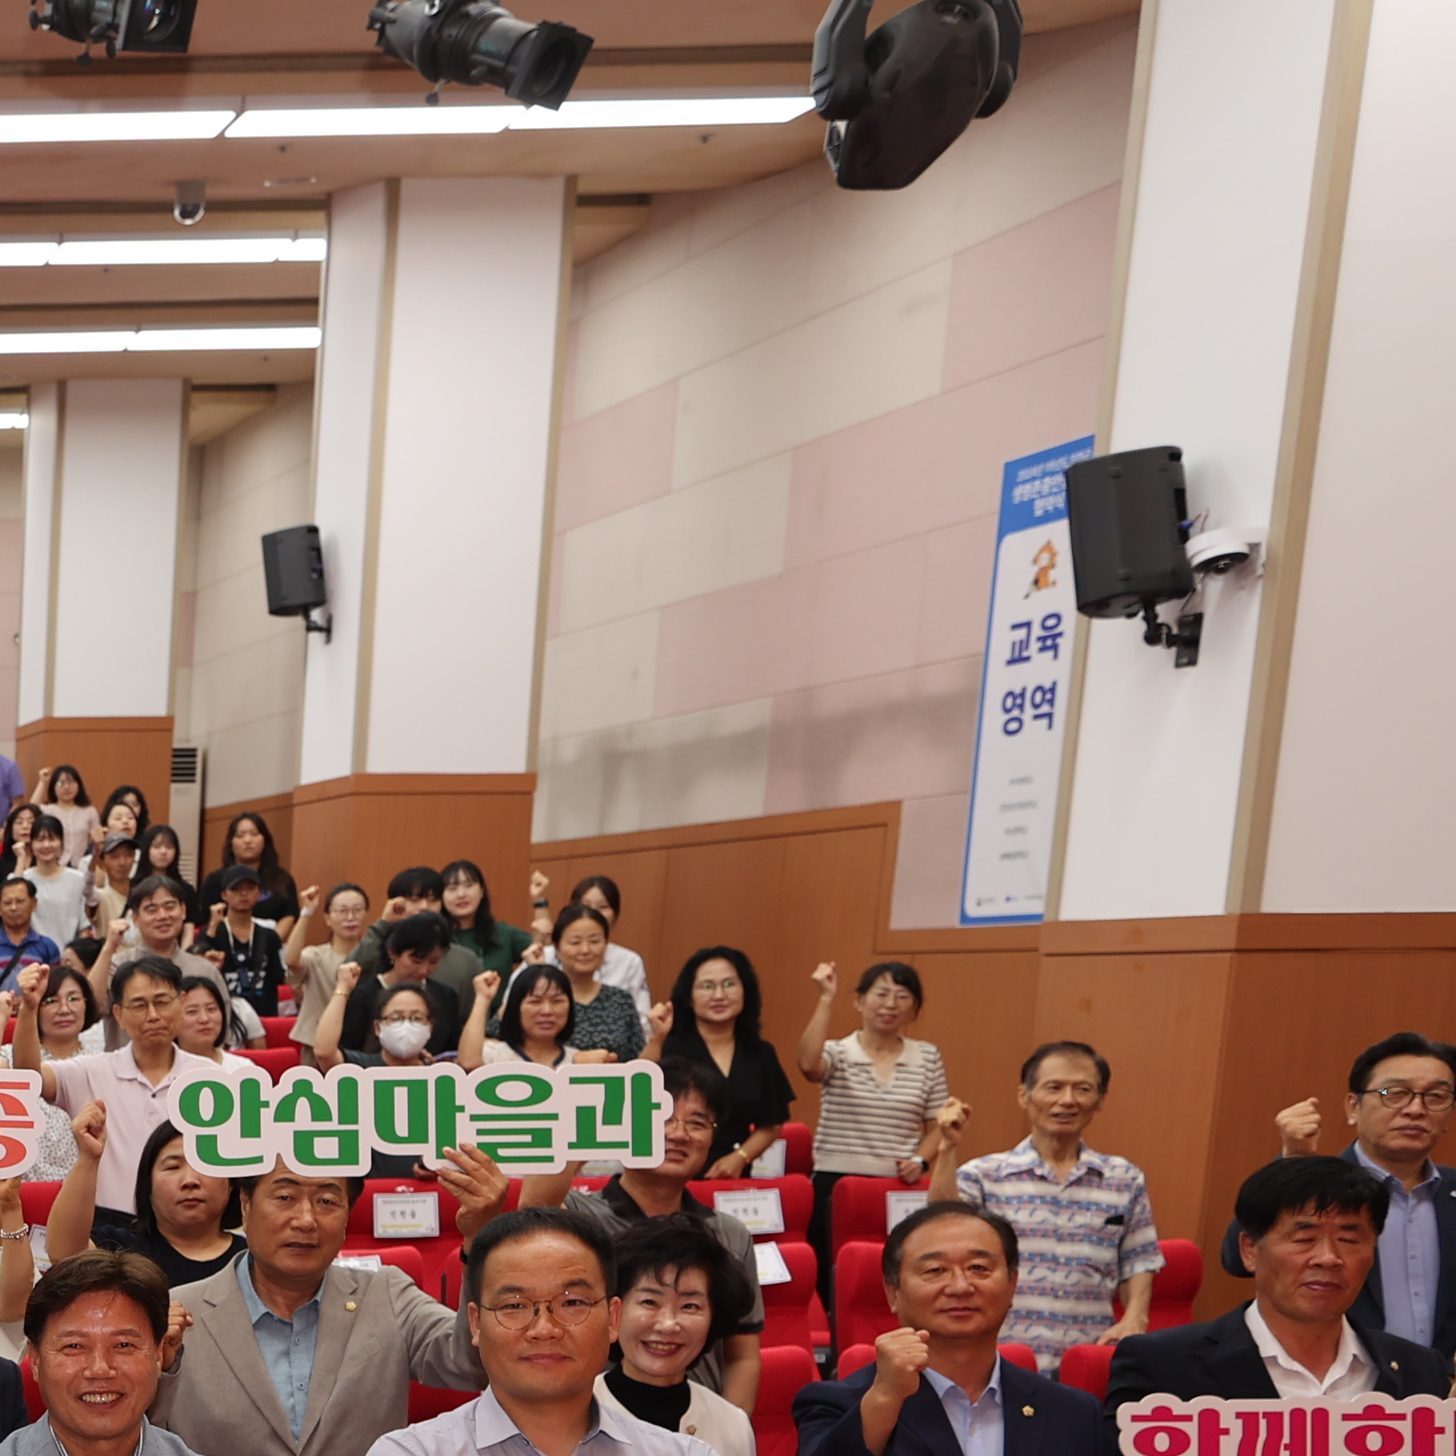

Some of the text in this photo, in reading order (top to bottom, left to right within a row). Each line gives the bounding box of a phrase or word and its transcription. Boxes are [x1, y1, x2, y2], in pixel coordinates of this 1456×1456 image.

[1005, 611, 1065, 668] 교육
[1002, 680, 1058, 736] 영역
[178, 1071, 662, 1167] 안심마을과
